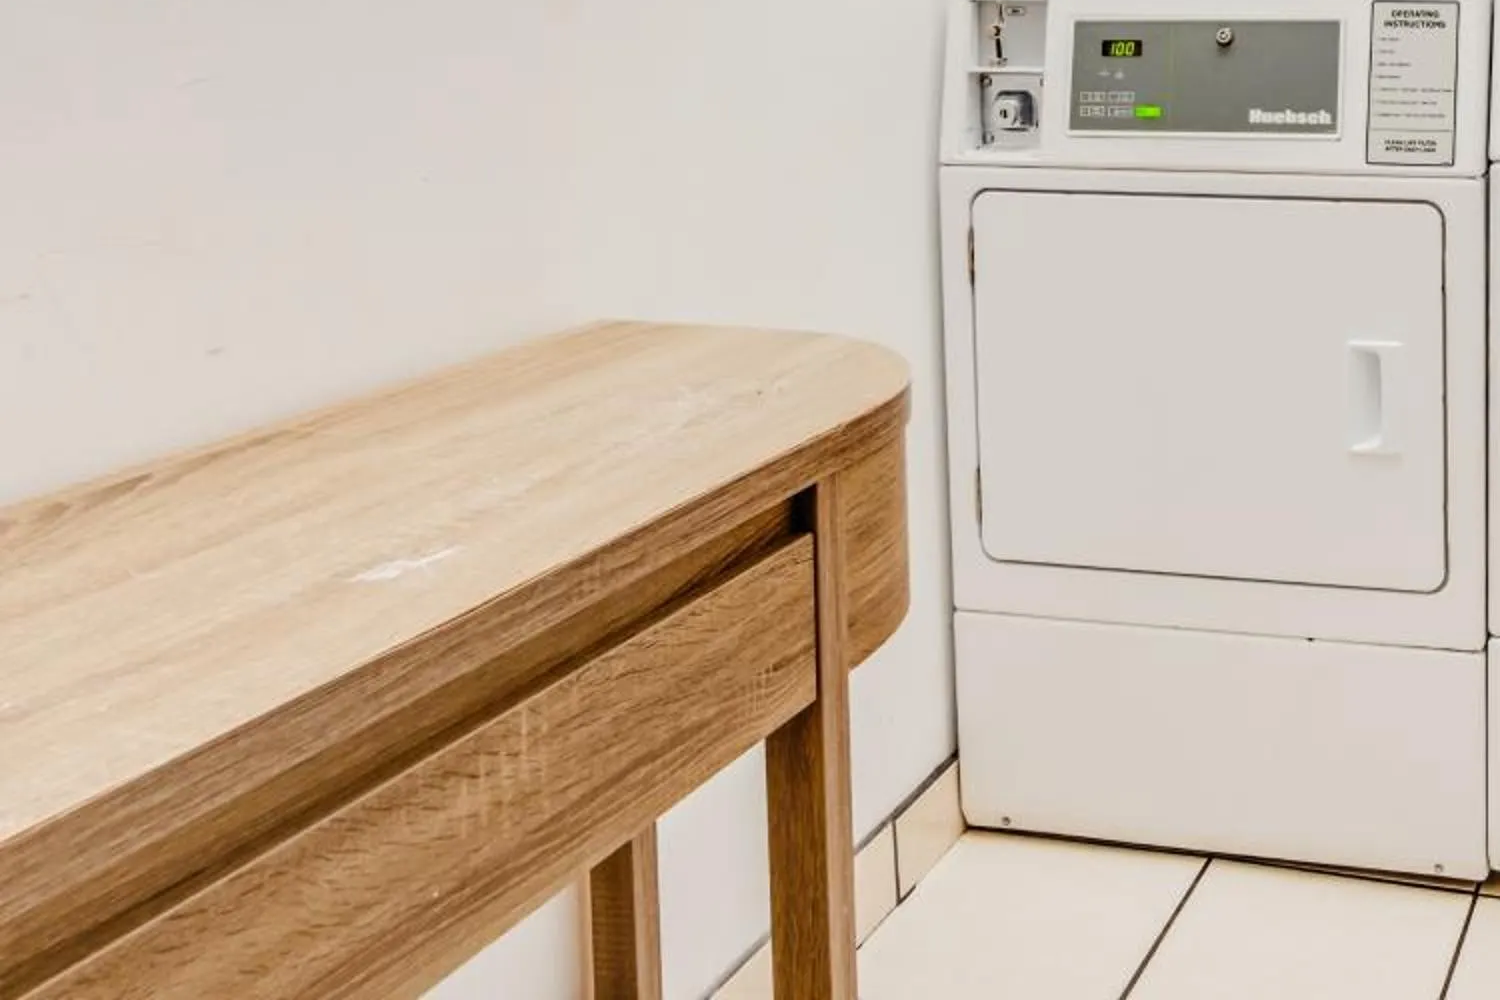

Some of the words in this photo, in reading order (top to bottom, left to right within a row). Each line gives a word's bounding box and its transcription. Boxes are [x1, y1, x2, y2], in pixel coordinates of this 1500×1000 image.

[1391, 9, 1440, 19] OPERATING
[1383, 20, 1446, 29] INSTRUCTIONS
[1110, 41, 1135, 56] 100
[1249, 108, 1332, 124] Huebsch
